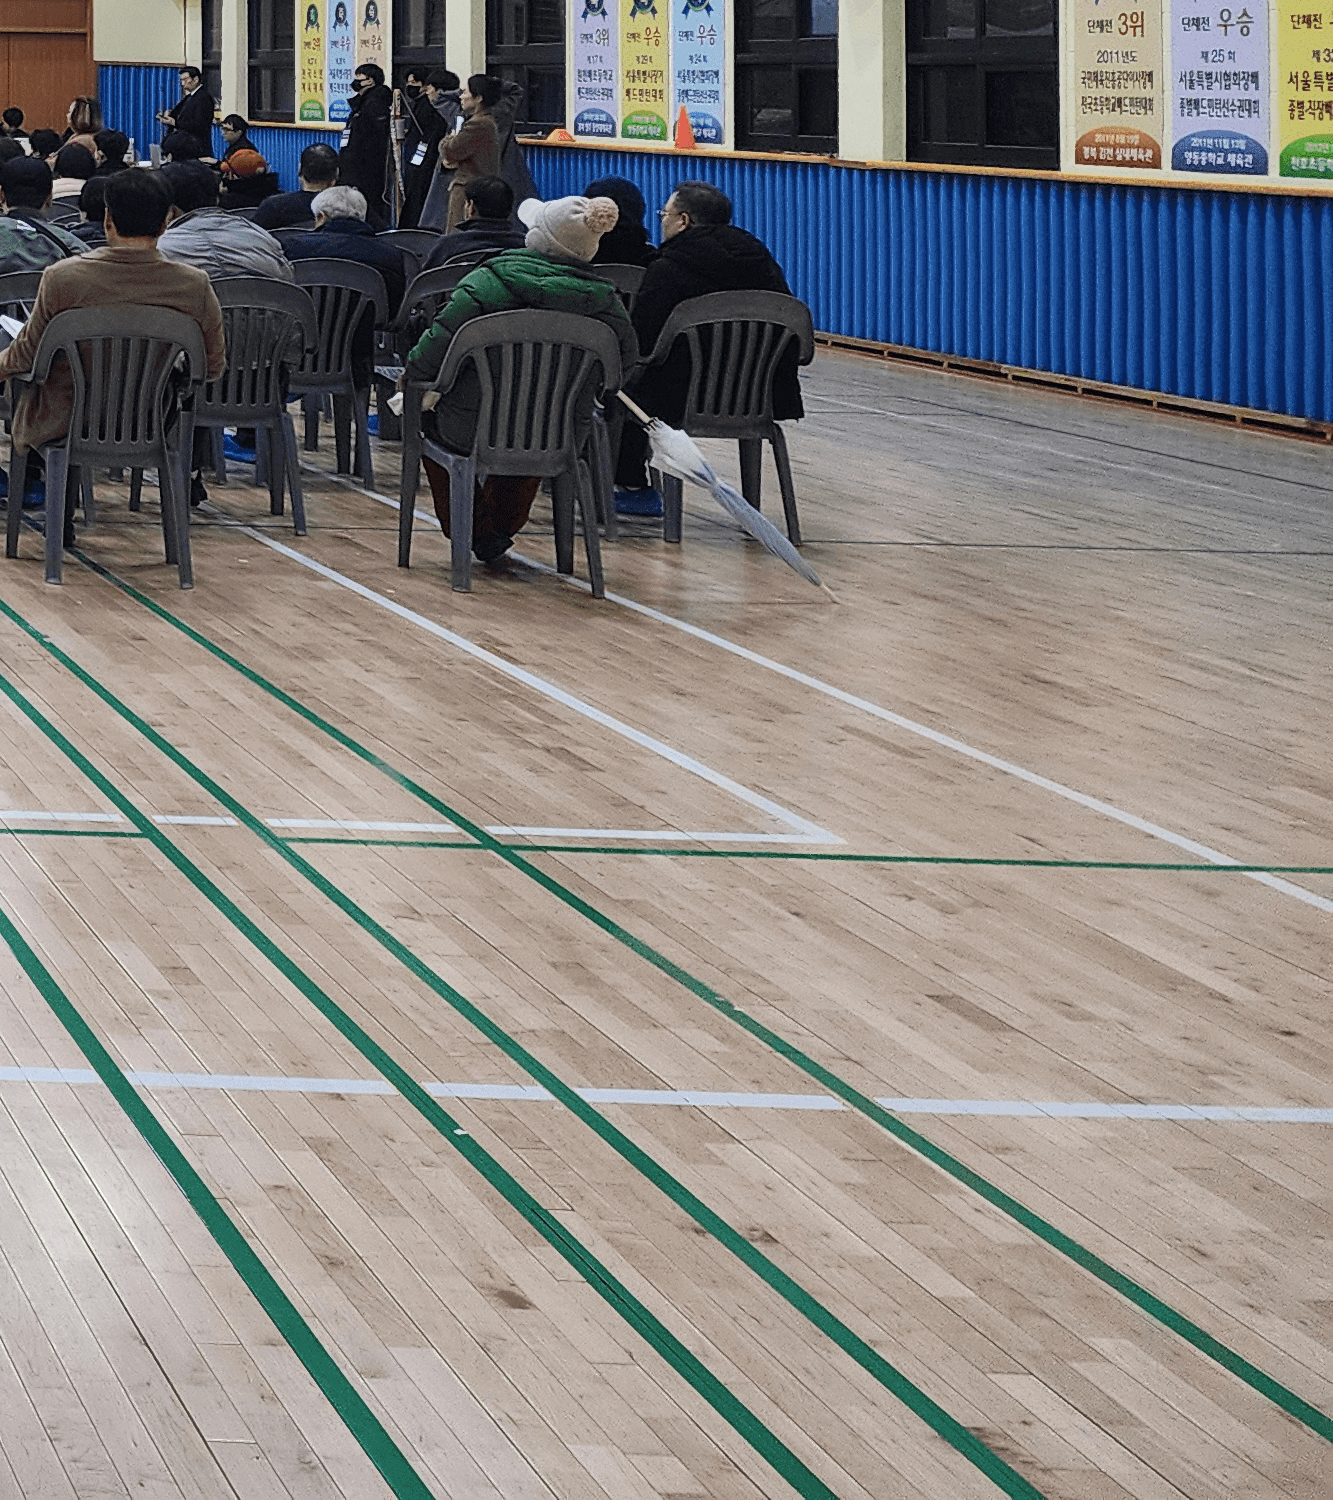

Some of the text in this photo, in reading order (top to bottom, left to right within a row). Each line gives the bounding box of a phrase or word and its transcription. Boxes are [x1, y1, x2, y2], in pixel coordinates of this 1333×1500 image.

[1087, 11, 1145, 38] 단체전 3위
[1181, 8, 1255, 37] 단체전 우승
[1289, 13, 1323, 30] 단체전
[595, 28, 610, 46] 3위
[644, 26, 661, 47] 우승
[696, 24, 717, 46] 우승
[1096, 49, 1138, 64] 2011년도
[1179, 70, 1260, 91] 서울특별시협회장배
[1179, 97, 1261, 119] 종별배드민턴선수권대회
